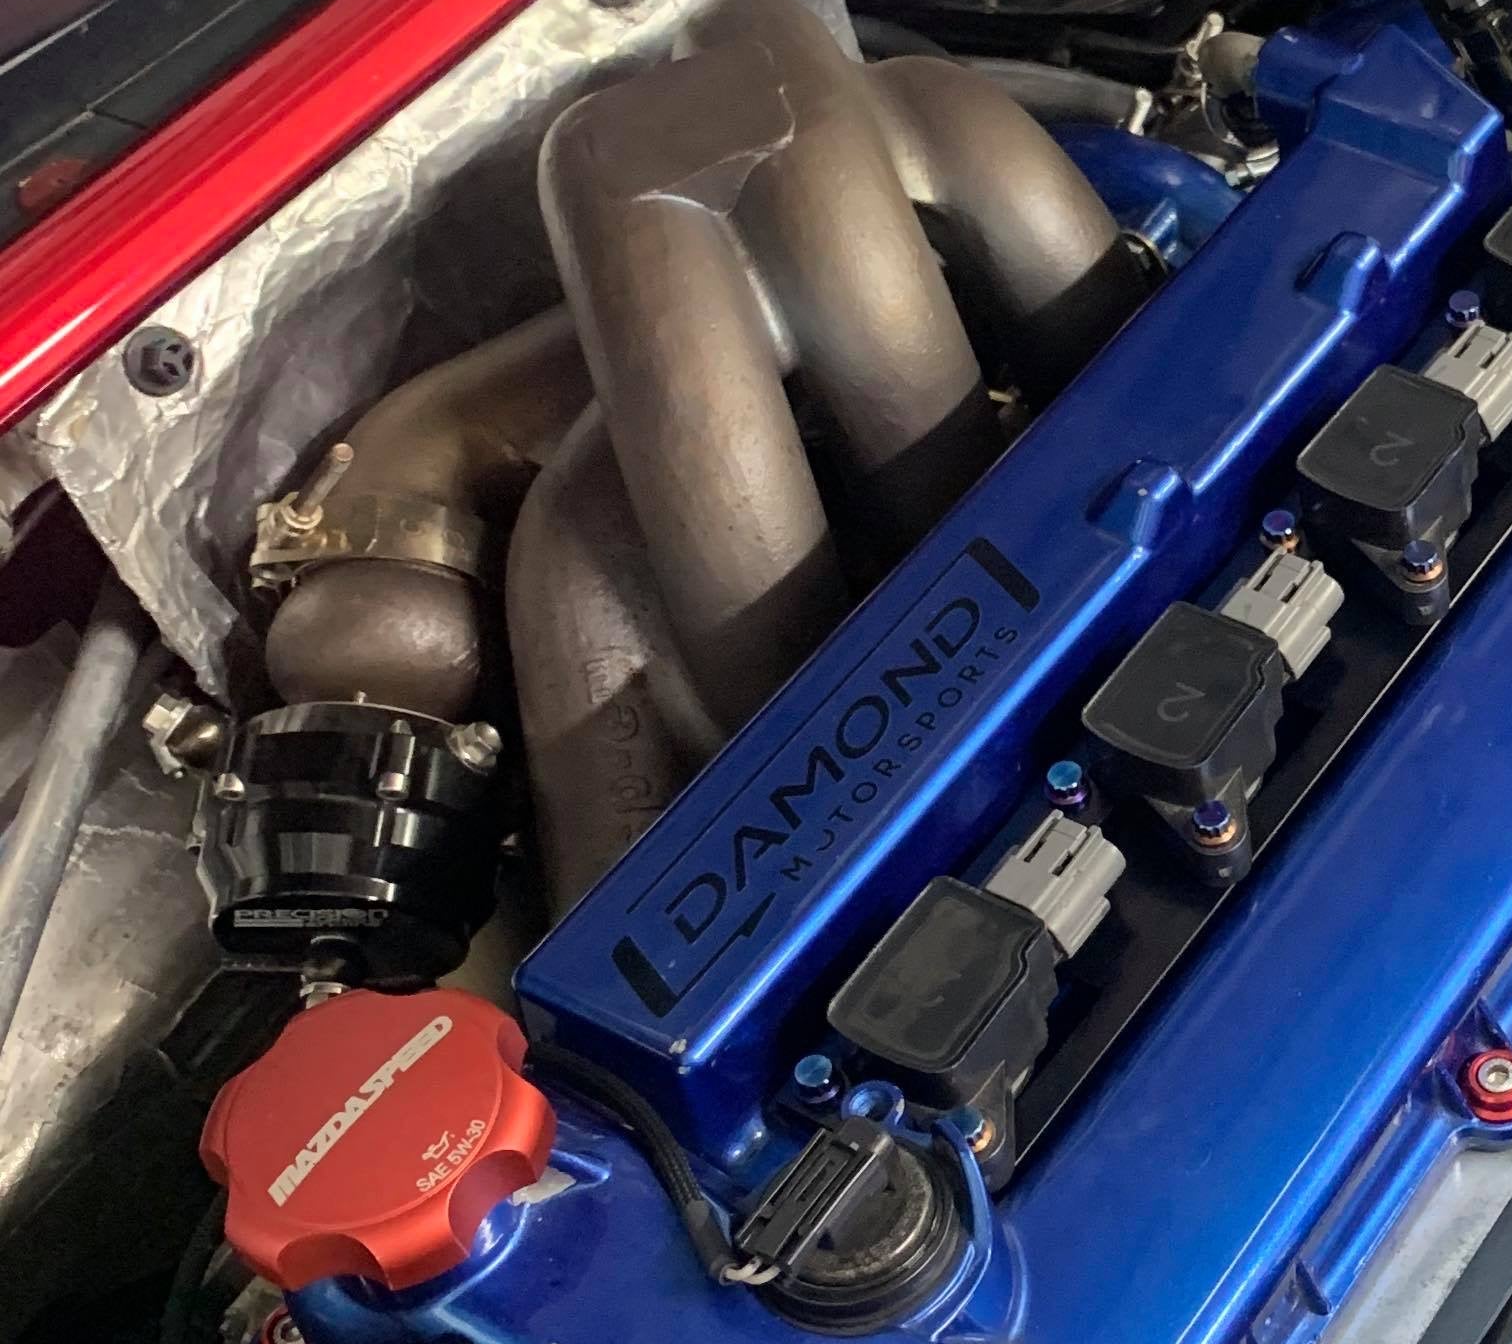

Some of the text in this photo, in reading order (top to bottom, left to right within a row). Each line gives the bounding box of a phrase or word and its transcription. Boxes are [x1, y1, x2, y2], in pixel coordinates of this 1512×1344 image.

[664, 595, 981, 944] DAMOND
[267, 1016, 453, 1208] MAZDASPEED
[416, 1119, 487, 1193] SAE 5W-30
